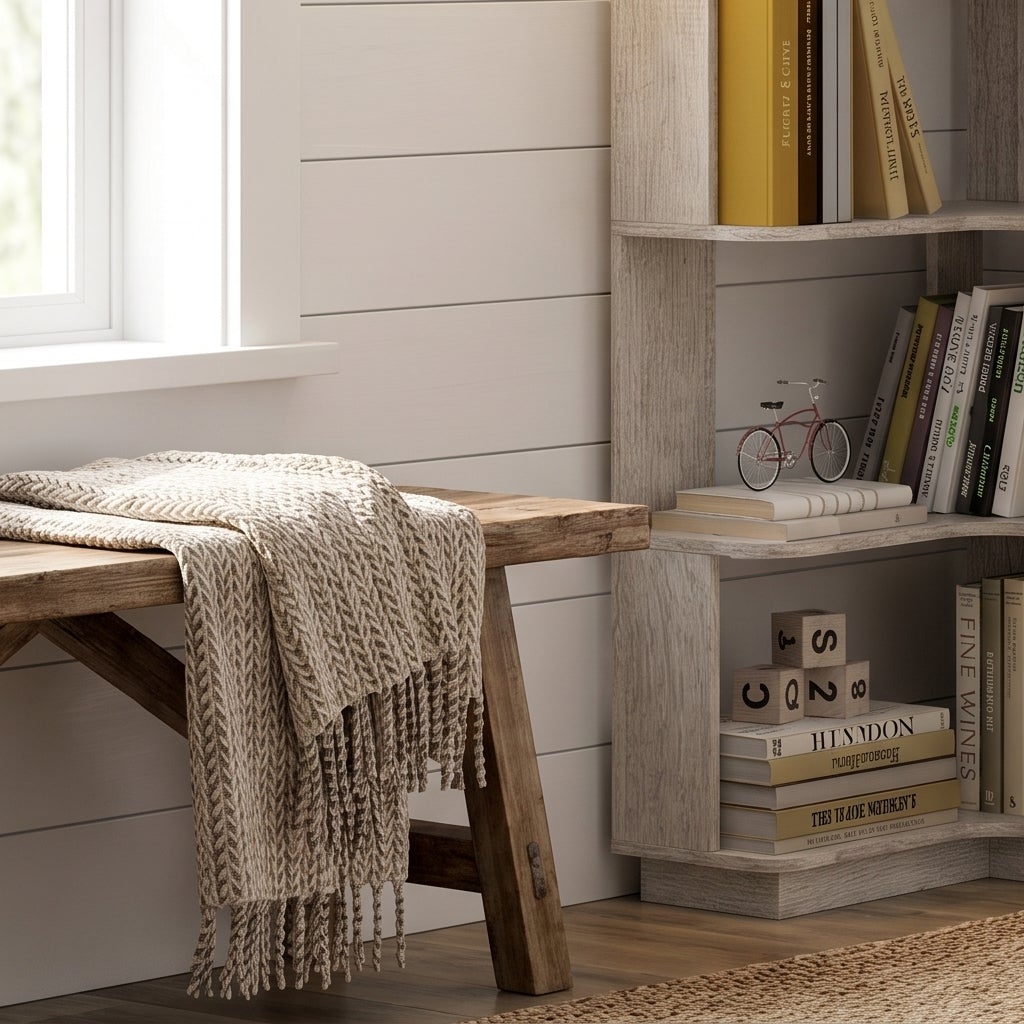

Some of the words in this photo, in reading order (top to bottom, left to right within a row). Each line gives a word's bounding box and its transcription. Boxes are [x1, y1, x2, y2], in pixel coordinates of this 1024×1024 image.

[960, 616, 976, 678] FINE
[742, 682, 770, 710] C
[785, 678, 799, 711] Q
[808, 680, 838, 702] 2
[851, 679, 867, 700] 8
[959, 690, 977, 782] WINES
